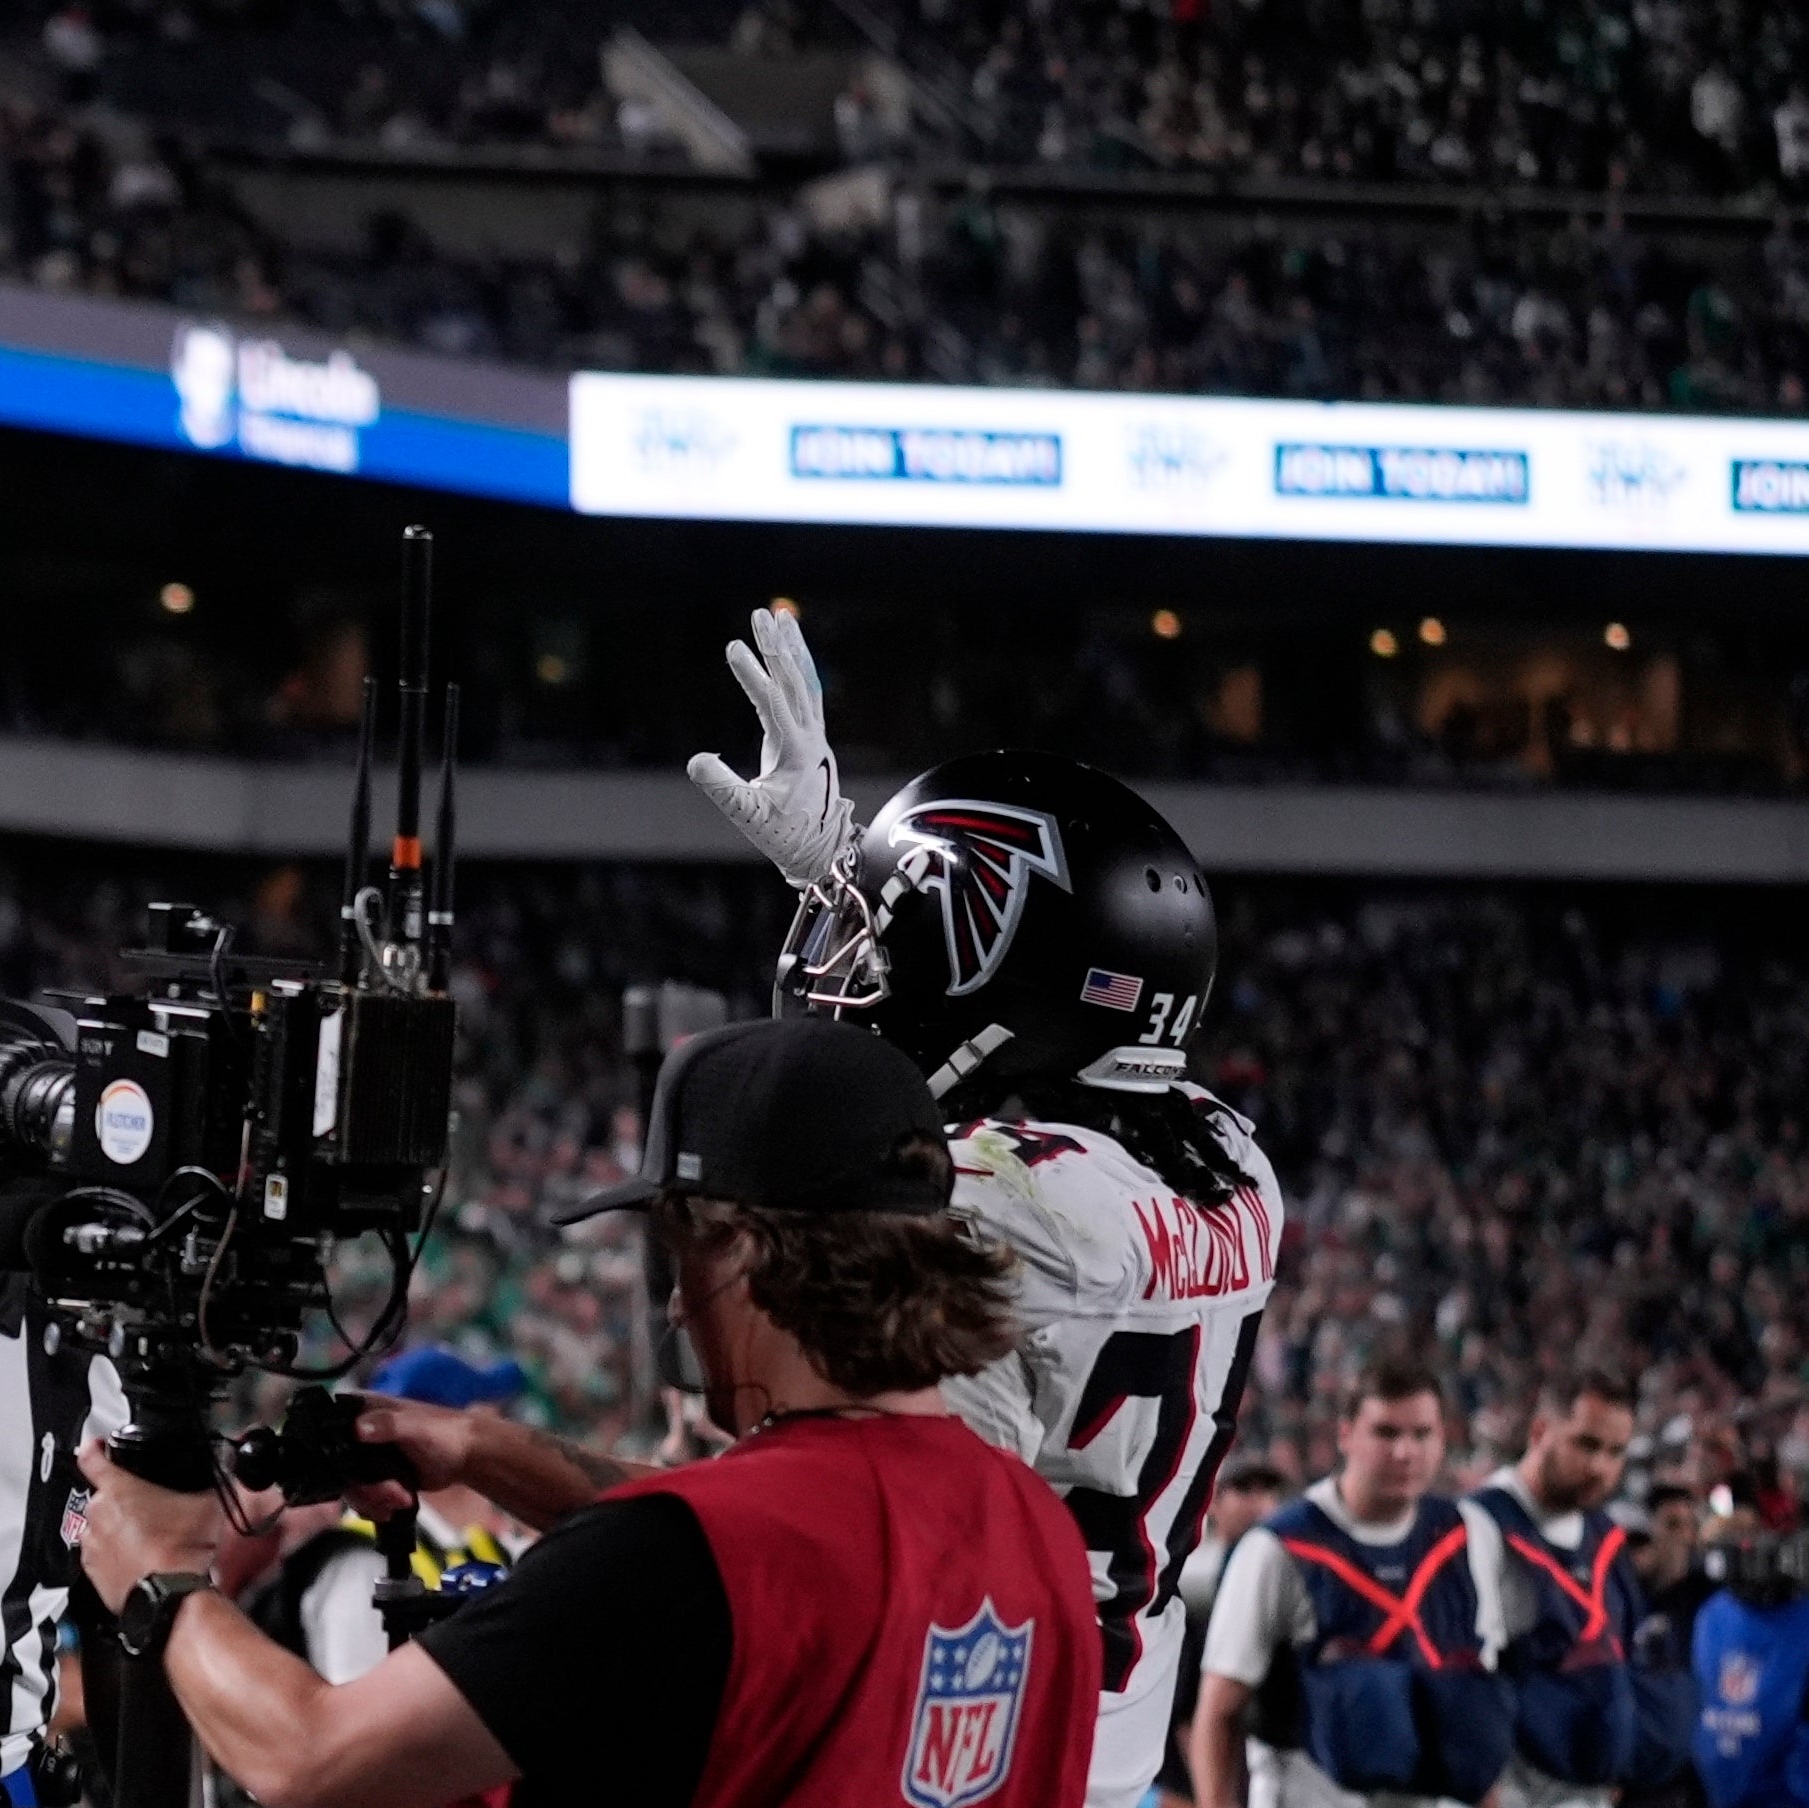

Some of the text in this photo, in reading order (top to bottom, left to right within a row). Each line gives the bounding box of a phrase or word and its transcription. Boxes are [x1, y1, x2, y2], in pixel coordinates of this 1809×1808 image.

[795, 428, 895, 478] JOIN
[1280, 445, 1374, 495] JOIN
[1138, 992, 1198, 1047] 34
[917, 1700, 997, 1797] NFL
